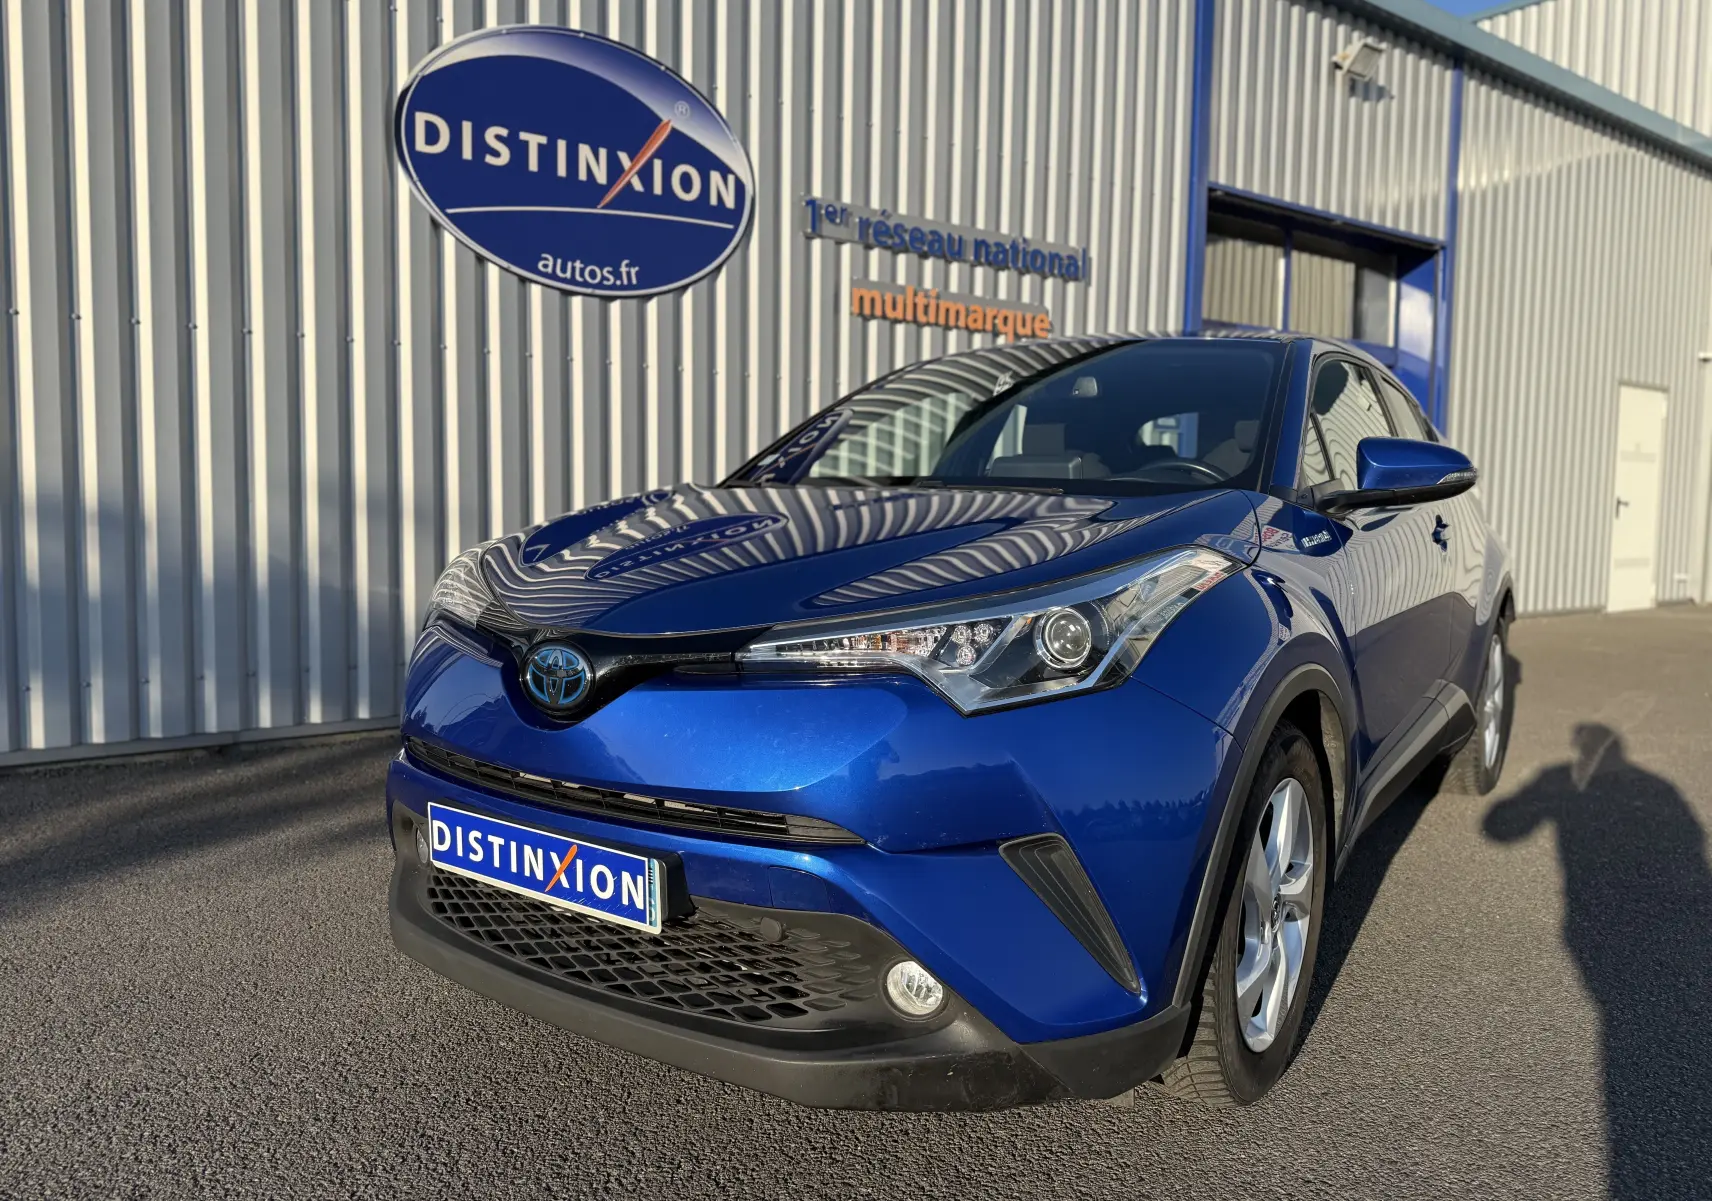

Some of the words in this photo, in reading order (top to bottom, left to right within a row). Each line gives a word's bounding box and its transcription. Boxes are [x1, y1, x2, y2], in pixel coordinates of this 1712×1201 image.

[414, 111, 736, 210] DISTINXION
[537, 253, 640, 286] autos.fr
[857, 208, 964, 260] réseau
[972, 236, 1088, 281] national
[851, 285, 1051, 344] multimarque
[431, 819, 645, 911] DISTINXION
